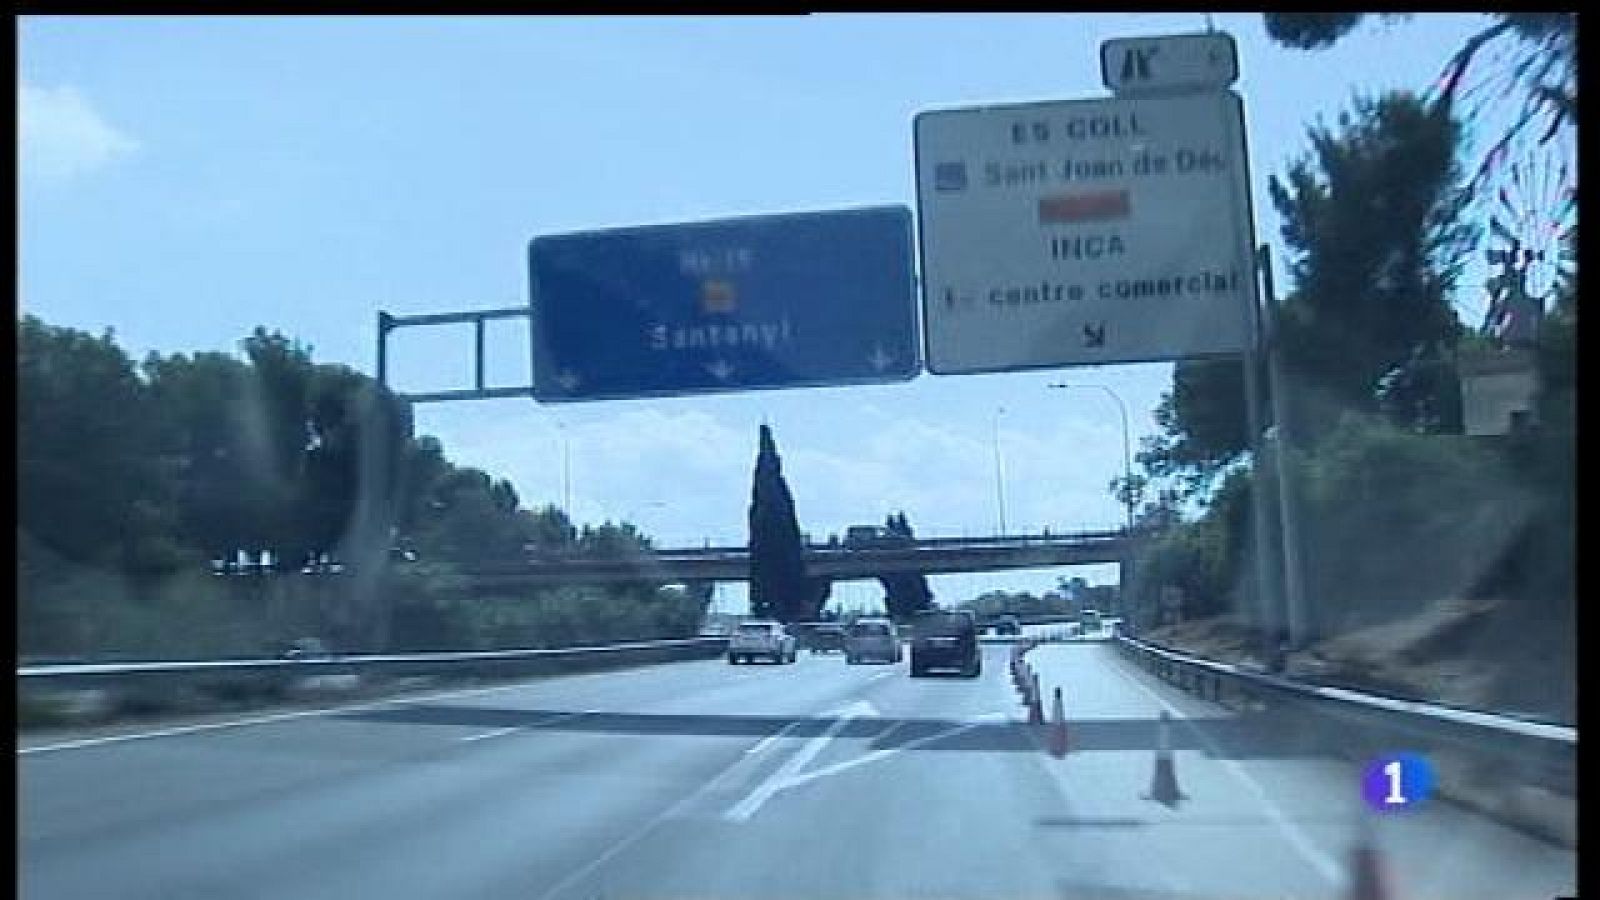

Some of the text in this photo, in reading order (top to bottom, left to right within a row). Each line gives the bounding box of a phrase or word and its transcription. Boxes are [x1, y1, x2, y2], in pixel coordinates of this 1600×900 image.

[1062, 155, 1123, 181] Joan
[1135, 152, 1168, 177] de
[1052, 233, 1126, 261] INCA
[988, 280, 1083, 306] centro
[1099, 270, 1240, 302] comercial
